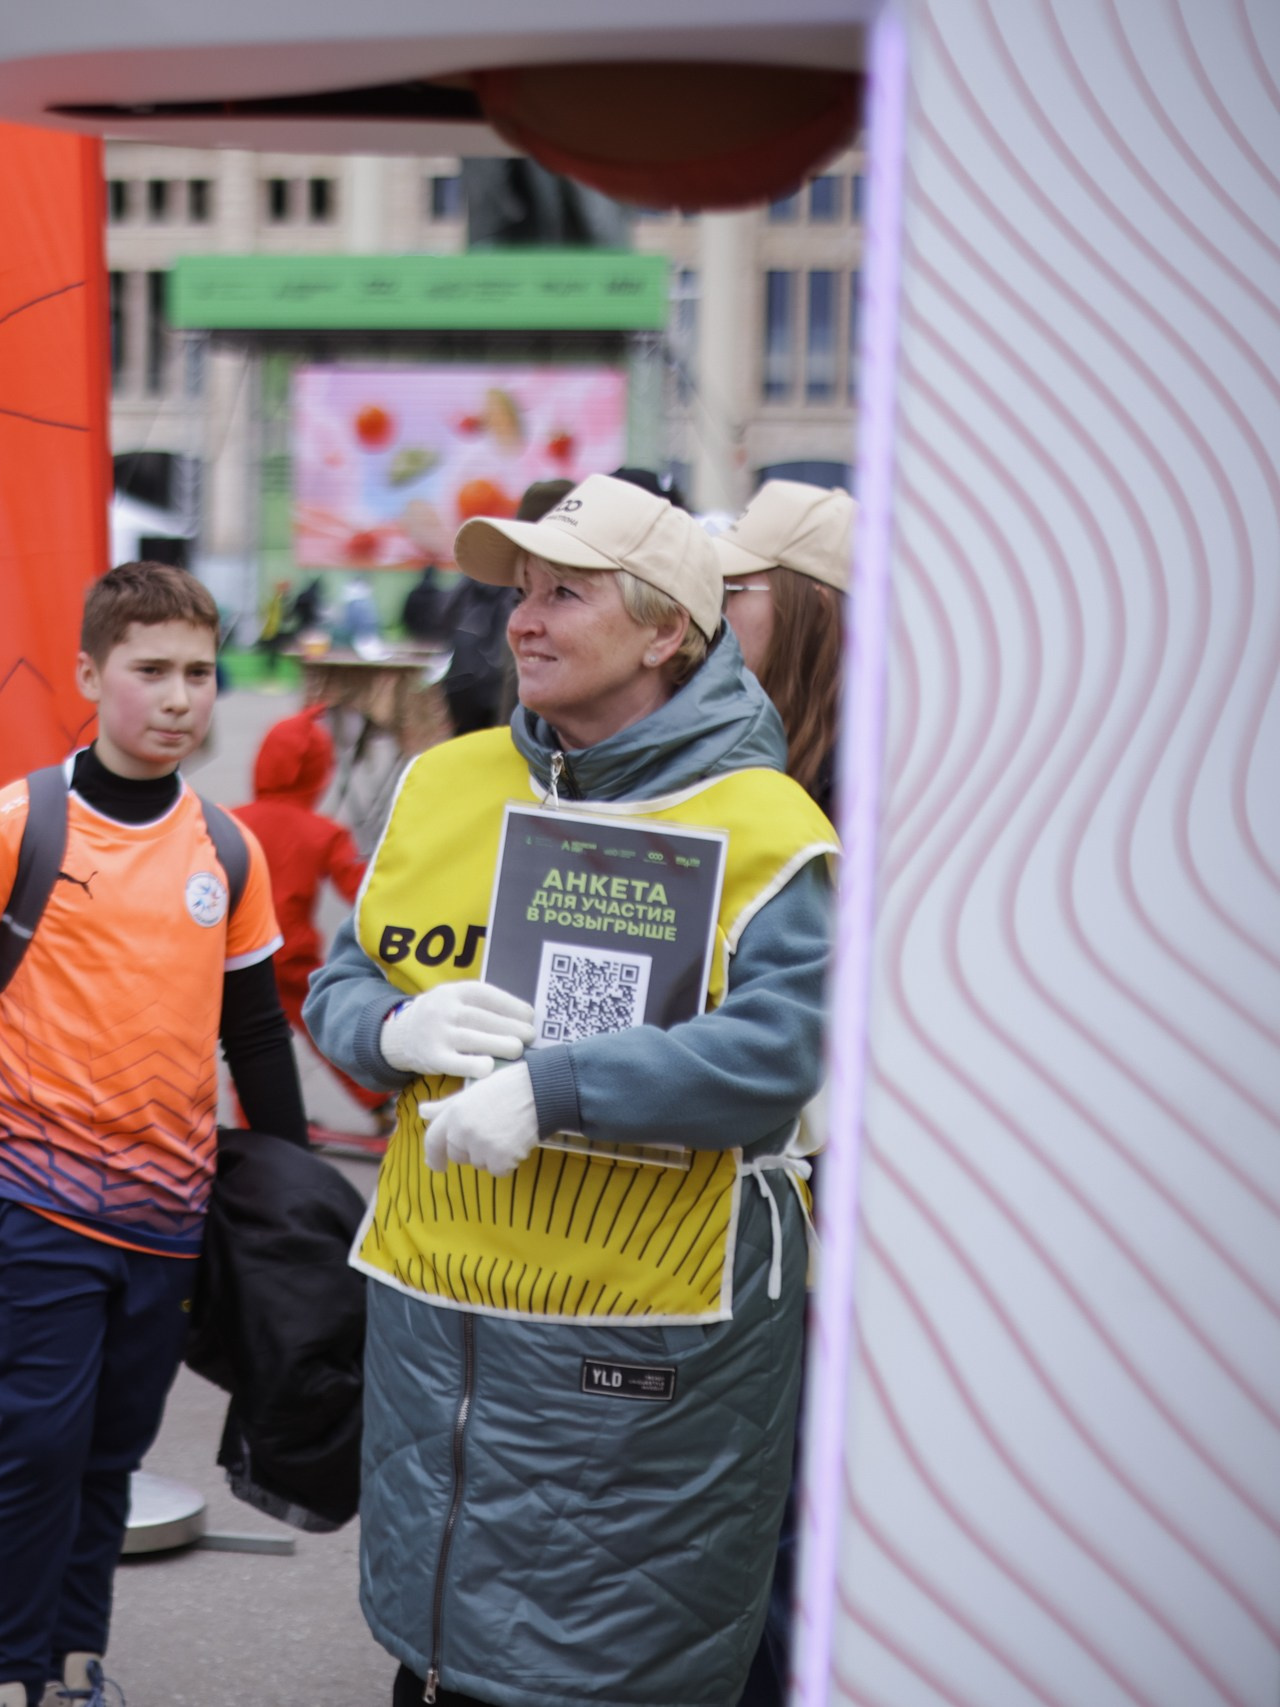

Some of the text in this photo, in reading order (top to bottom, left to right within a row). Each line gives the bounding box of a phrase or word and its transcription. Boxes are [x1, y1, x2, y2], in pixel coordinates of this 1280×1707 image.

[542, 868, 668, 905] АНКЕТА
[526, 906, 678, 942] В РОЗЫГРЫШЕ
[531, 889, 676, 924] ДЛЯ УЧАСТИЯ
[592, 1368, 622, 1388] YLD
